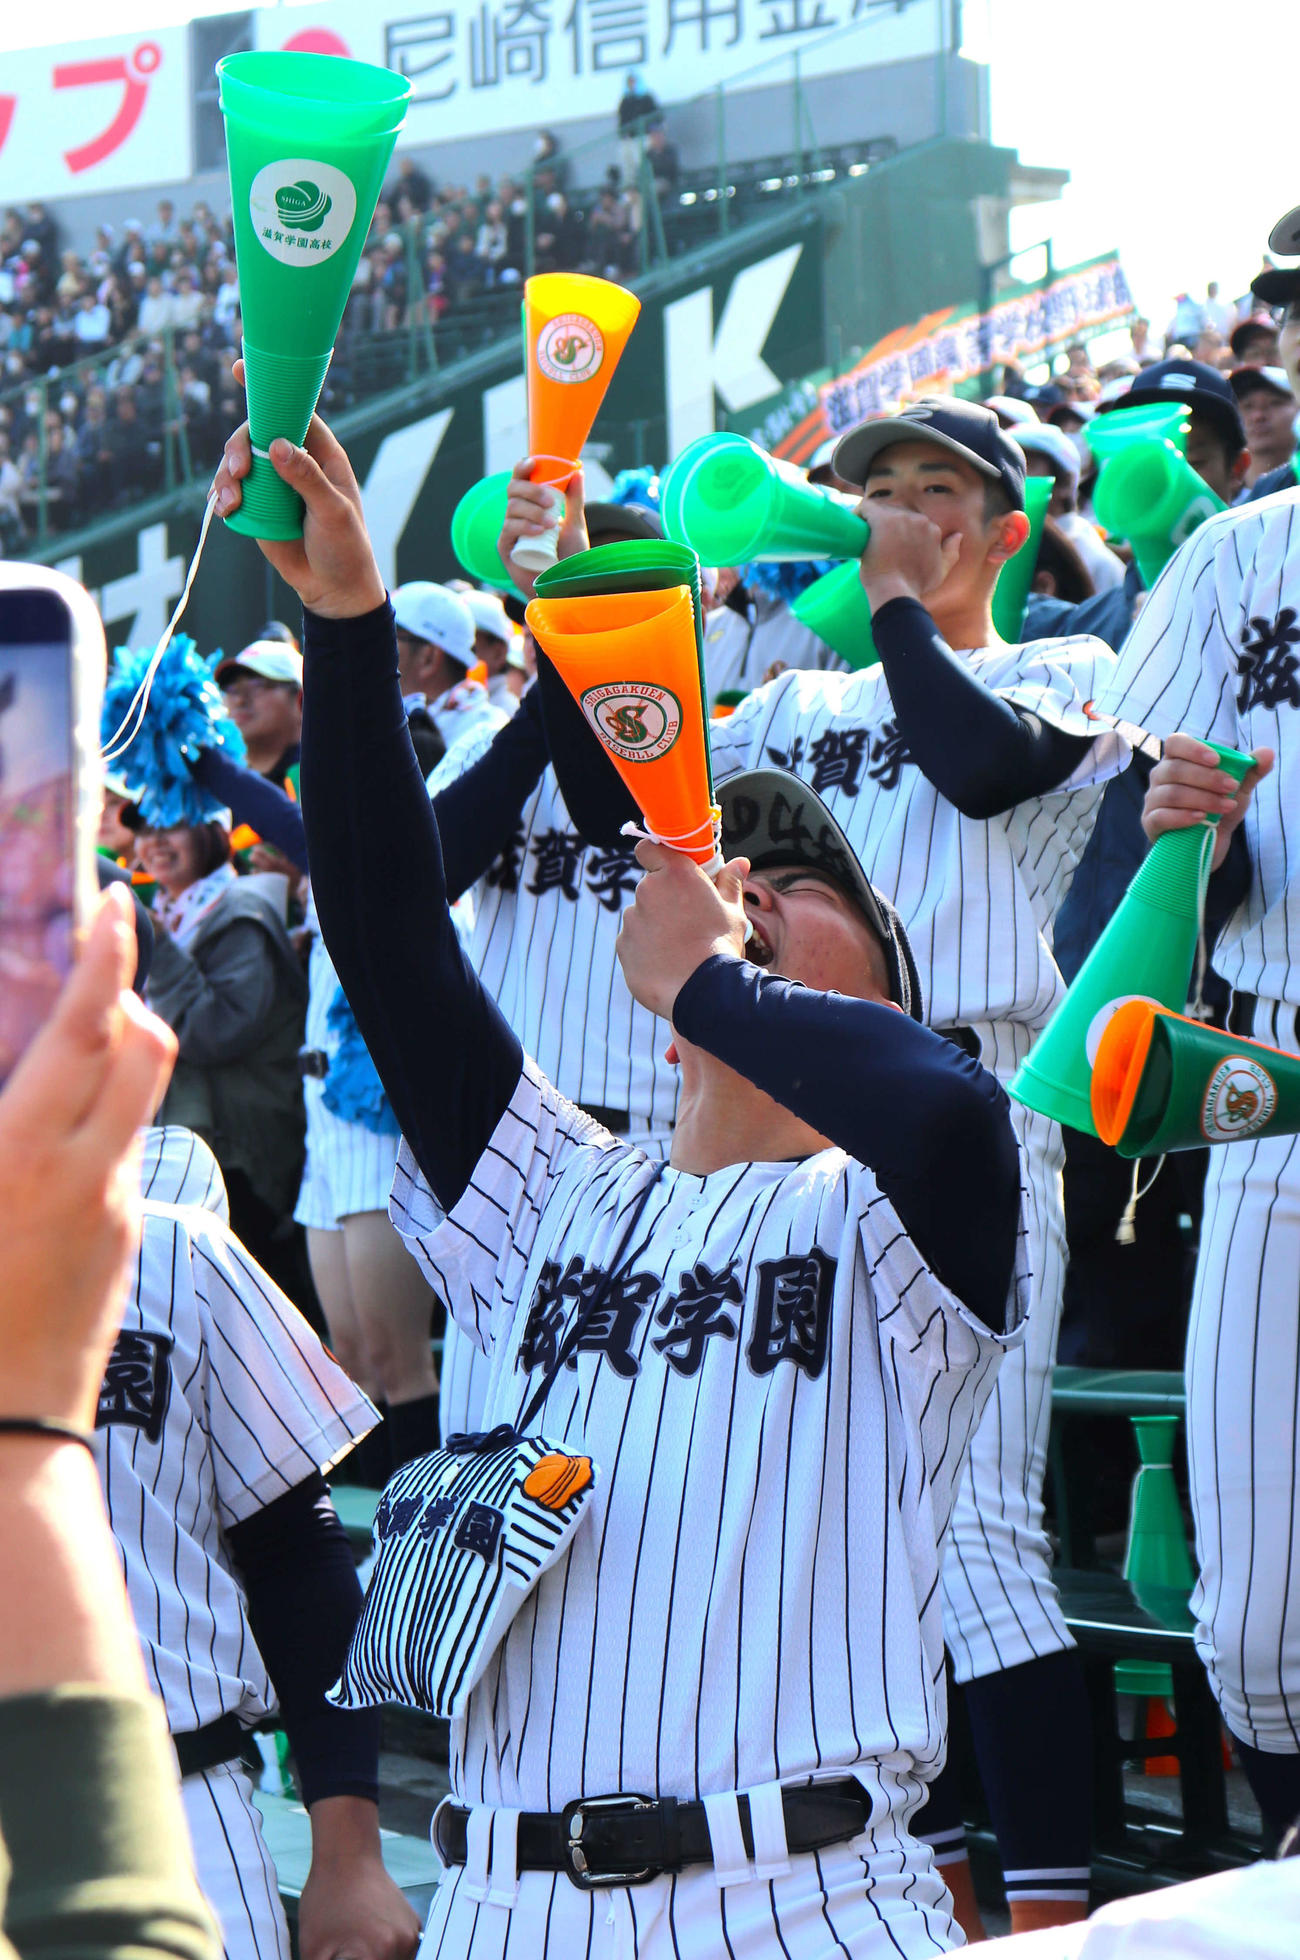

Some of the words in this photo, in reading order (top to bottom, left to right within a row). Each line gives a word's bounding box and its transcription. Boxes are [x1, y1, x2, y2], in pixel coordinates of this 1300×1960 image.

[382, 0, 908, 104] 尼崎信用
[0, 40, 162, 174] プ
[261, 227, 332, 250] 滋賀学園高校
[584, 685, 666, 707] SHIGAGAKUEN
[656, 720, 678, 750] CLUB
